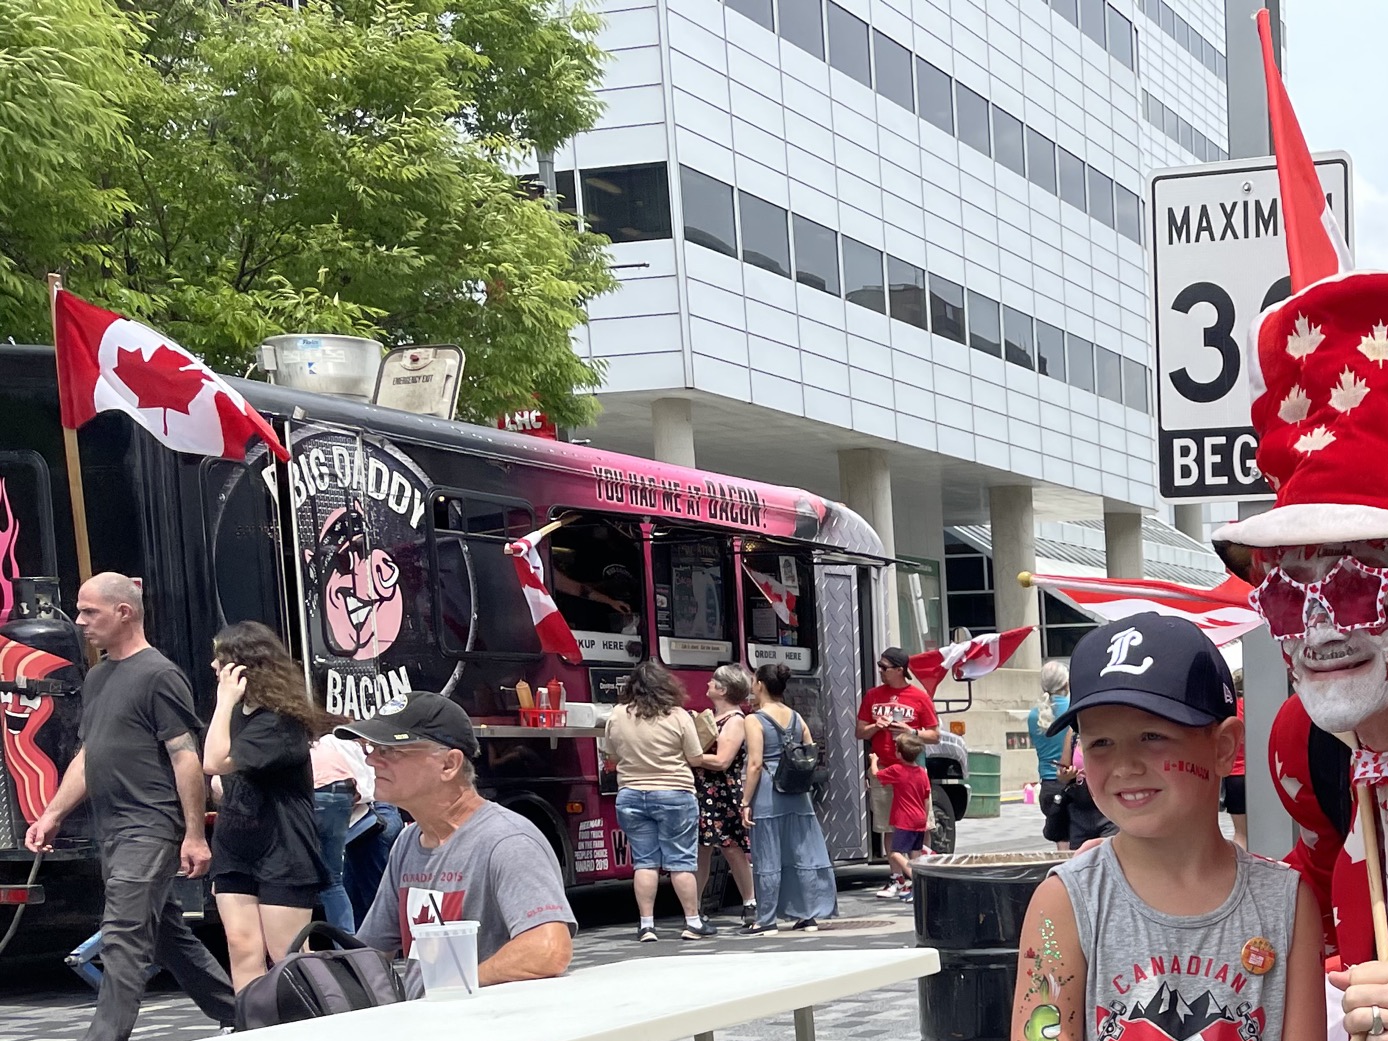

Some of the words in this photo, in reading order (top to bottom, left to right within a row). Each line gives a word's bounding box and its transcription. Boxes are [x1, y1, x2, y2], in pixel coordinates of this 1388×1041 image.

[1168, 196, 1280, 245] MAXIM
[1169, 277, 1285, 403] 3
[393, 376, 420, 386] EMERGENCY
[421, 374, 434, 384] EXIT
[505, 410, 542, 431] LHC
[1172, 433, 1262, 487] BEG
[333, 445, 425, 530] DADDY
[593, 466, 625, 503] YOU
[628, 472, 657, 508] HAD
[662, 479, 681, 513] ME
[687, 486, 702, 516] AT
[704, 479, 767, 529] BACON!
[578, 639, 596, 649] KUP
[602, 641, 624, 650] HERE
[755, 650, 777, 659] ORDER
[785, 652, 802, 661] HERE
[326, 666, 412, 720] BACON
[1185, 762, 1210, 781] CANADA
[595, 858, 609, 871] 2019
[1112, 954, 1248, 995] CANADIAN
